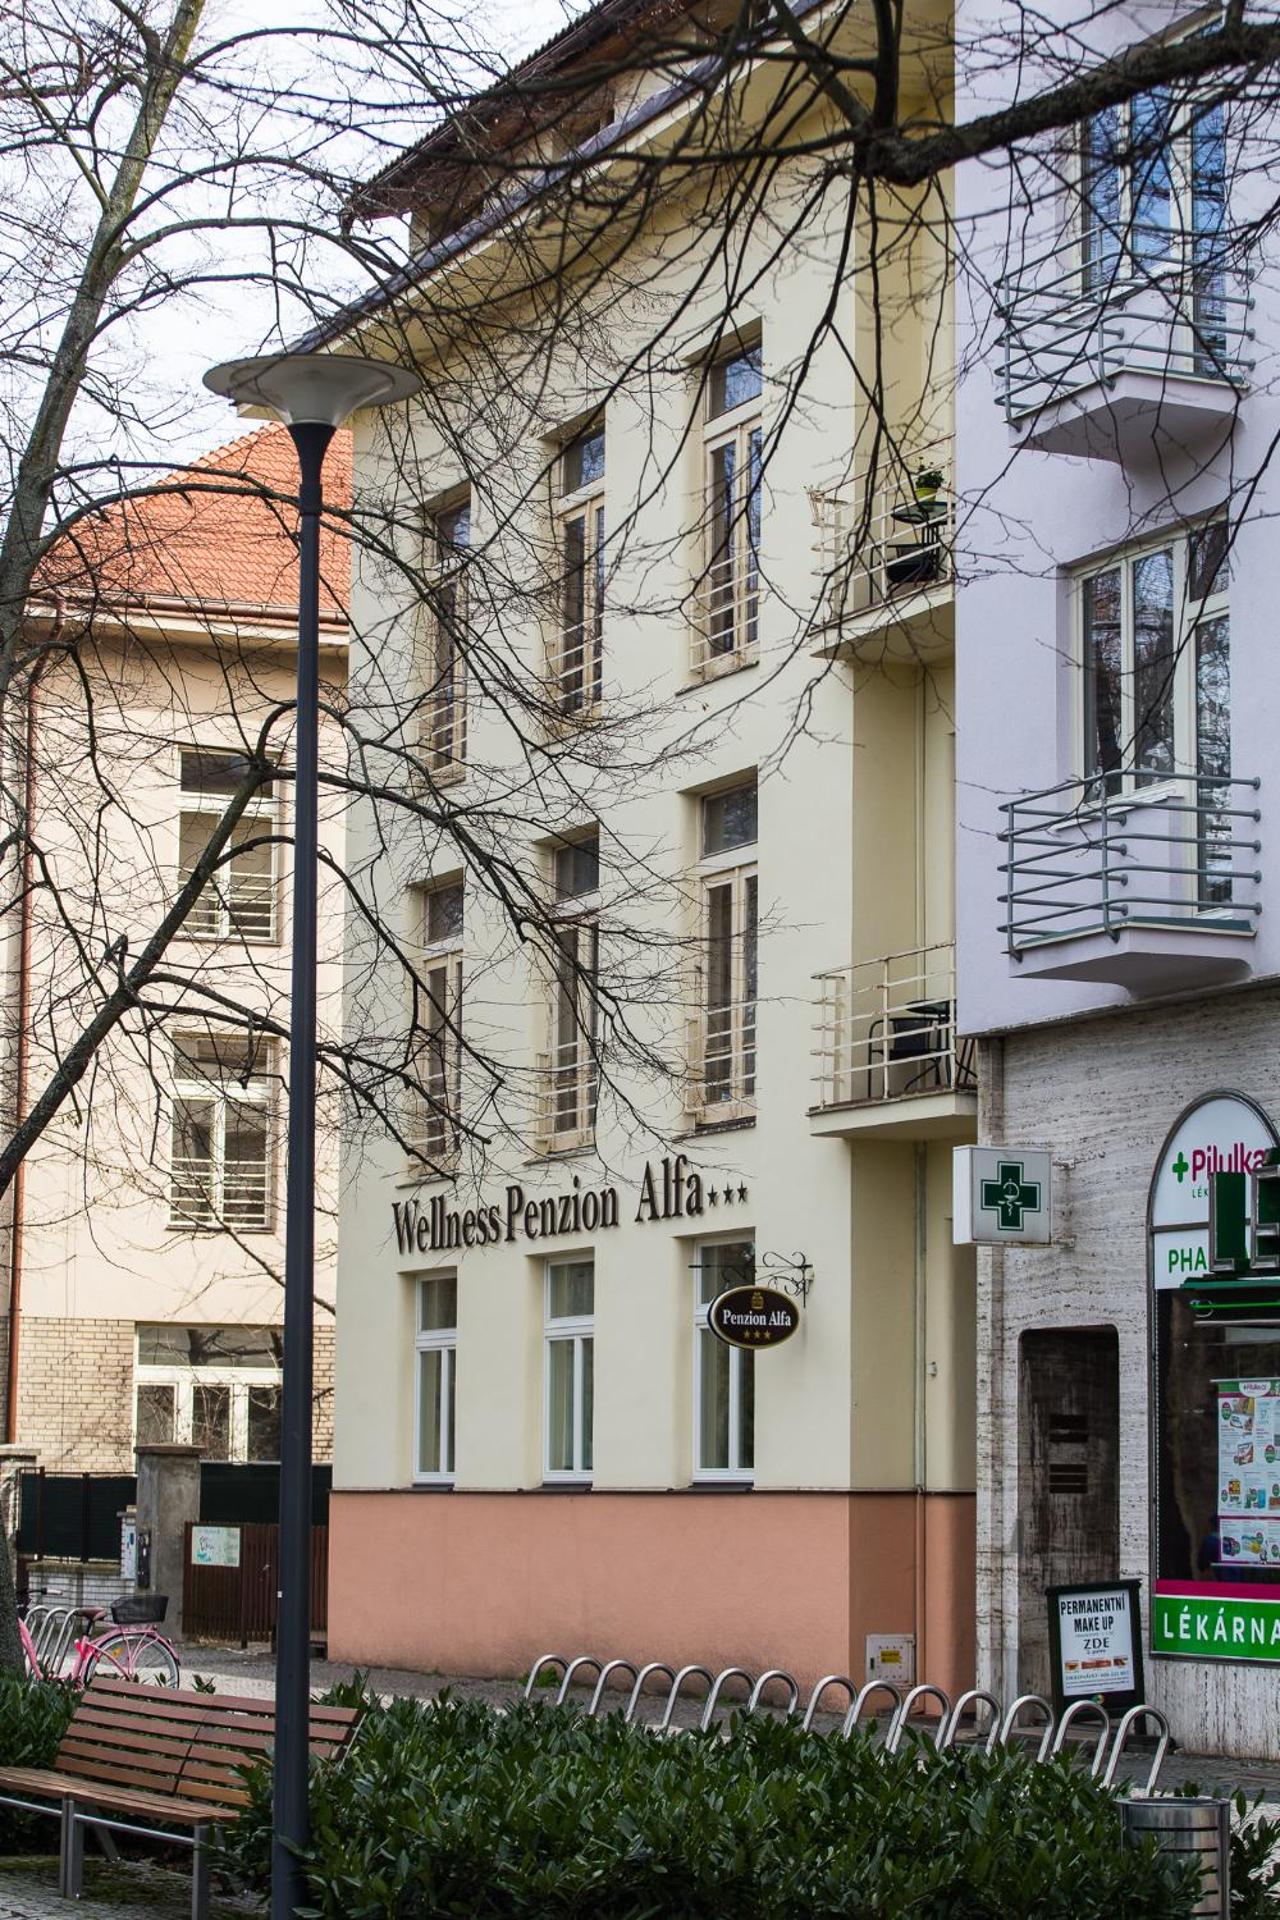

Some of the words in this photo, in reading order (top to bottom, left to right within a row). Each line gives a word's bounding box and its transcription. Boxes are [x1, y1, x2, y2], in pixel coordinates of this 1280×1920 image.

[392, 1195, 500, 1254] Wellness
[504, 1175, 619, 1242] Penzion
[635, 1154, 704, 1222] Alfa
[1168, 1246, 1207, 1273] PHA
[723, 1309, 767, 1326] Penzion
[769, 1311, 791, 1327] Alfa
[1060, 1594, 1125, 1615] PERMANENTNÍ
[1074, 1617, 1100, 1632] MAKE
[1102, 1615, 1114, 1630] UP
[1164, 1605, 1280, 1645] LÉKÁRNA
[1083, 1637, 1110, 1650] ZDE
